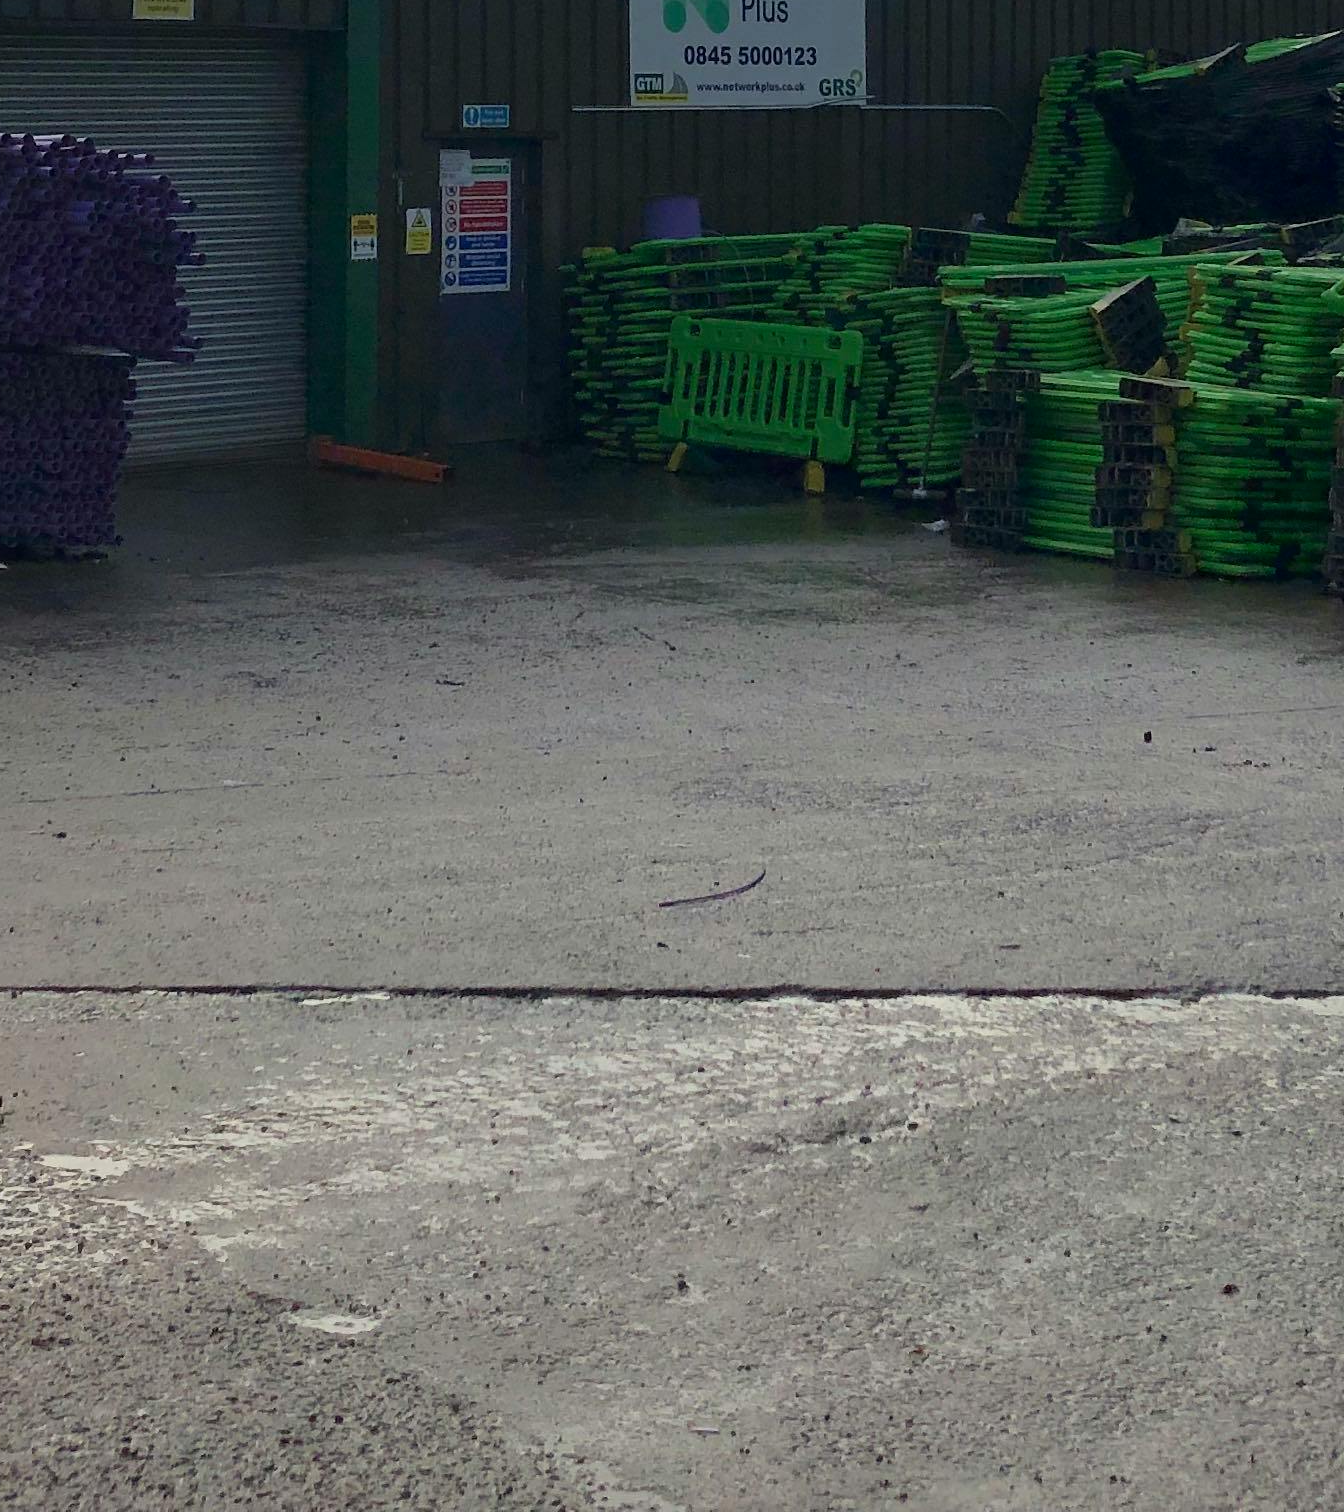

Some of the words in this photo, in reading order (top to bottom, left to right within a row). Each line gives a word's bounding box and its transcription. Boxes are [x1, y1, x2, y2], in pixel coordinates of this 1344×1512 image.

[684, 45, 732, 66] 0845
[738, 46, 817, 66] 5000123
[636, 76, 662, 91] GTM
[696, 81, 805, 94] www.networkplus.co.uk
[819, 78, 857, 97] GRS
